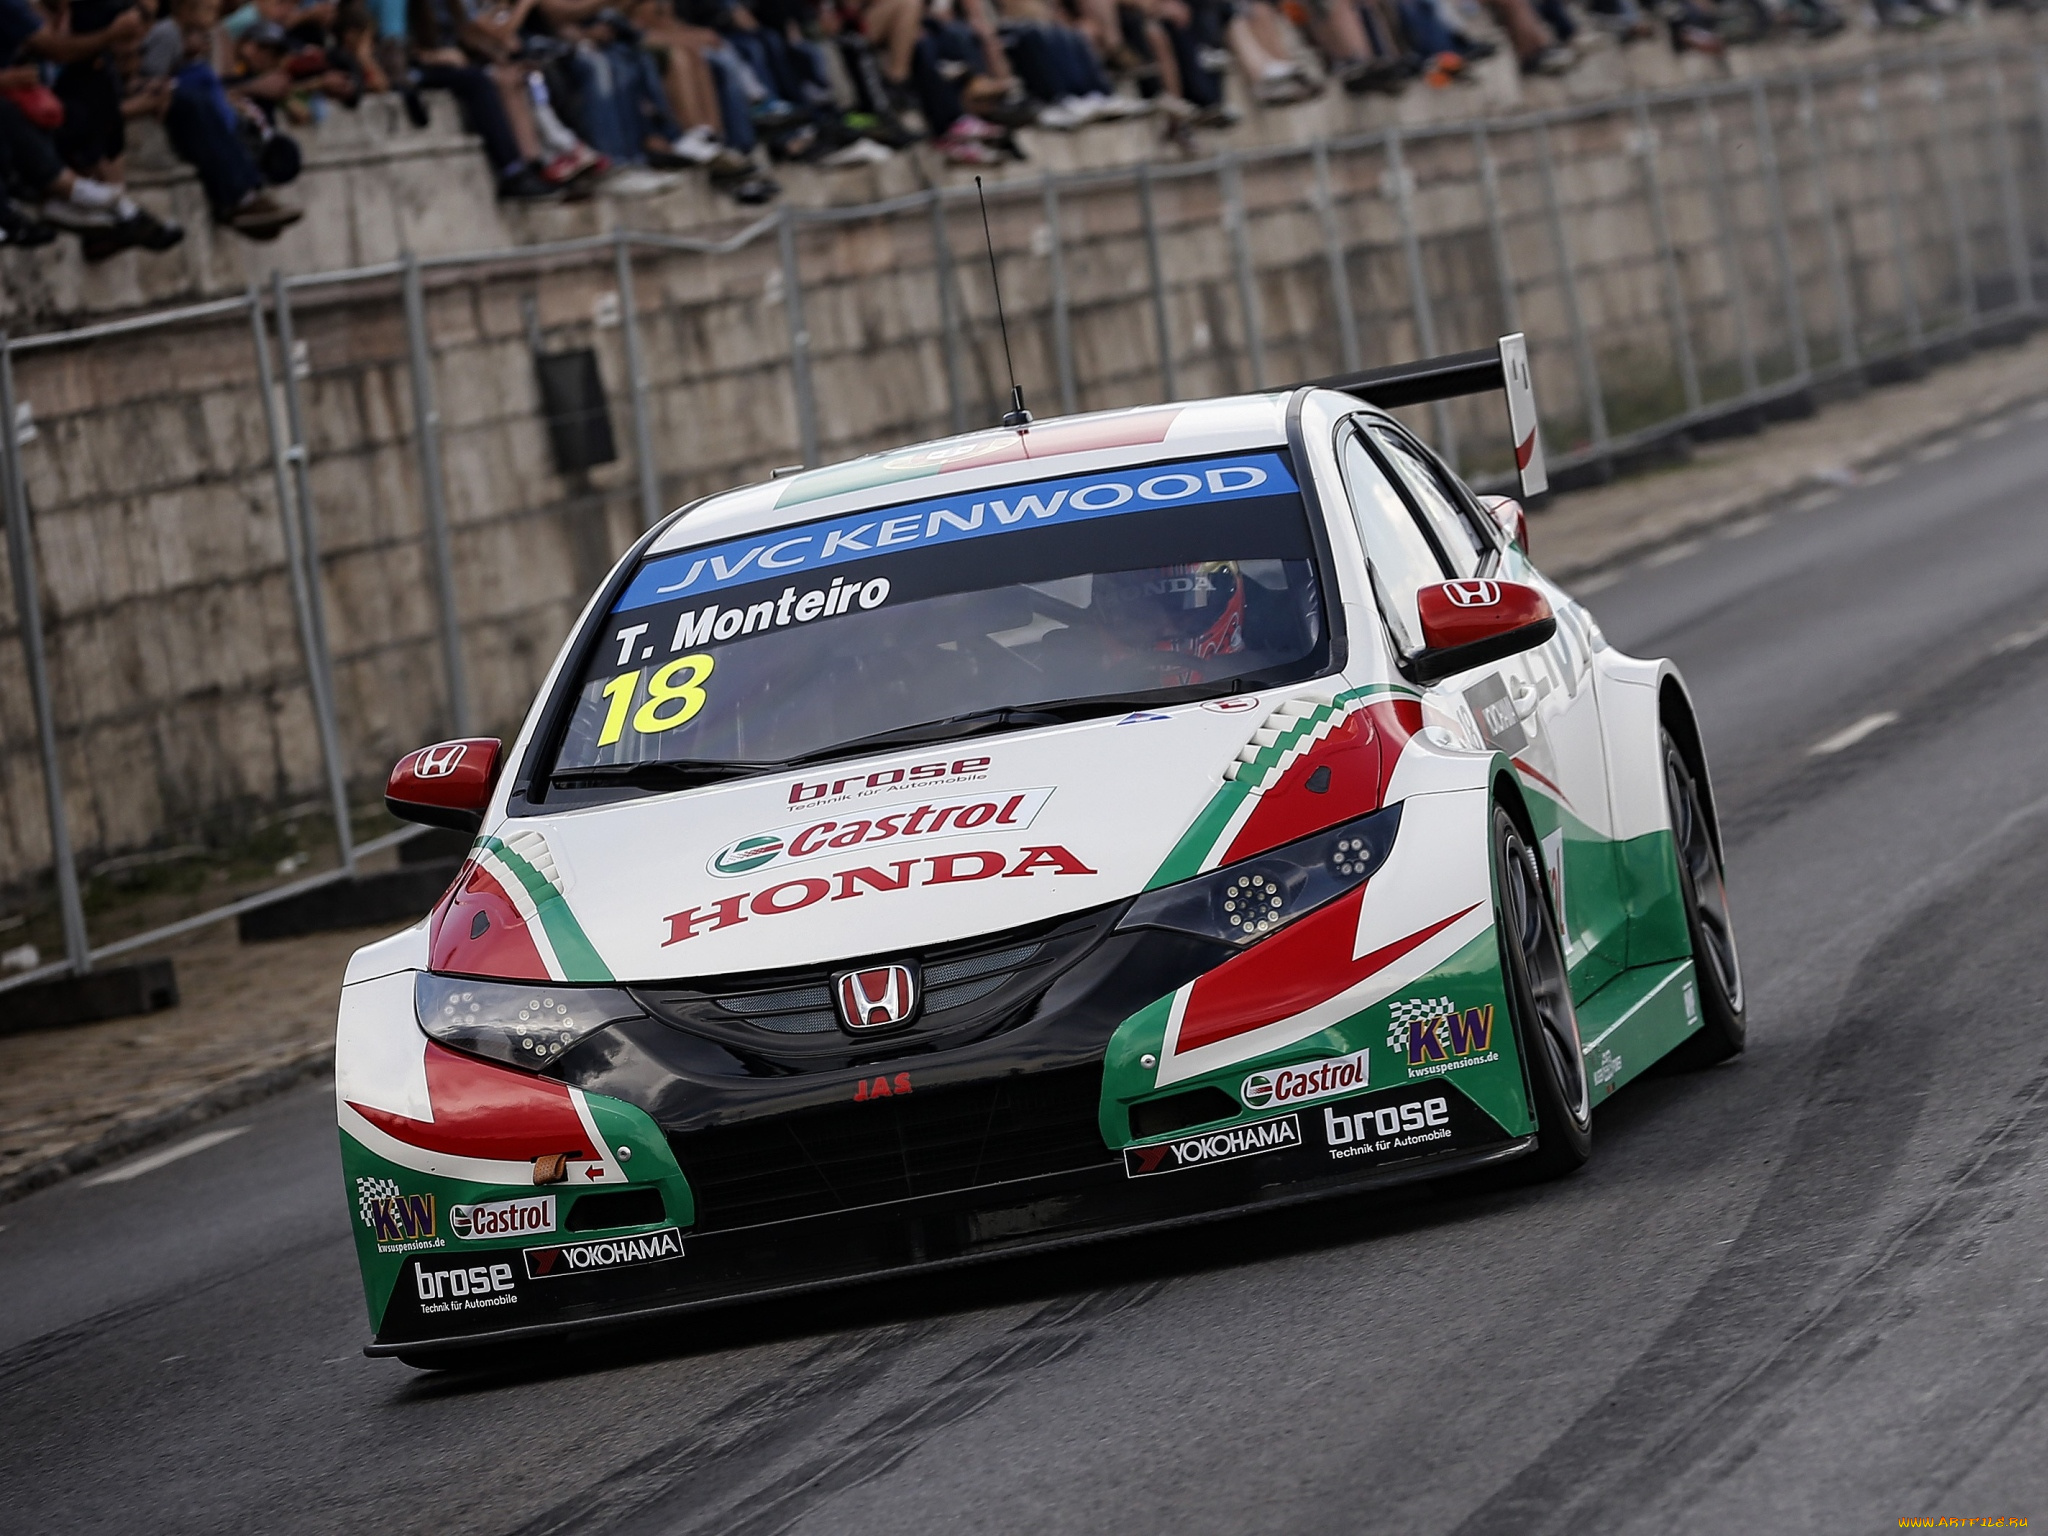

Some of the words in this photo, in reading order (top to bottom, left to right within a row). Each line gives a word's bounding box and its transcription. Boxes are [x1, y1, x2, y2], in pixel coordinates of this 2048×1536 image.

[615, 622, 655, 667] T.
[670, 576, 892, 654] Monteiro
[597, 653, 716, 748] 18
[786, 793, 852, 812] Technik
[857, 788, 882, 798] für
[886, 773, 988, 792] Automobile
[787, 756, 991, 804] brose
[788, 793, 1028, 858] Castrol
[660, 844, 1098, 948] HONDA
[1408, 1003, 1494, 1065] KW
[1274, 1055, 1364, 1101] Castrol
[1407, 1051, 1500, 1078] kwsuspensions.de
[853, 1072, 912, 1102] JAS
[1170, 1121, 1296, 1165] YOKOHAMA
[1324, 1097, 1450, 1146] brose
[1329, 1144, 1374, 1160] Technik
[1375, 1139, 1391, 1152] für
[1393, 1128, 1452, 1148] Automobile
[370, 1193, 436, 1242] KW
[471, 1200, 552, 1236] Castrol
[377, 1236, 446, 1254] kwsuspensions.de
[562, 1233, 680, 1270] YOKOHAMA
[414, 1261, 515, 1300] brose
[420, 1302, 450, 1315] Technik
[450, 1300, 463, 1311] für
[464, 1293, 518, 1310] Automobile
